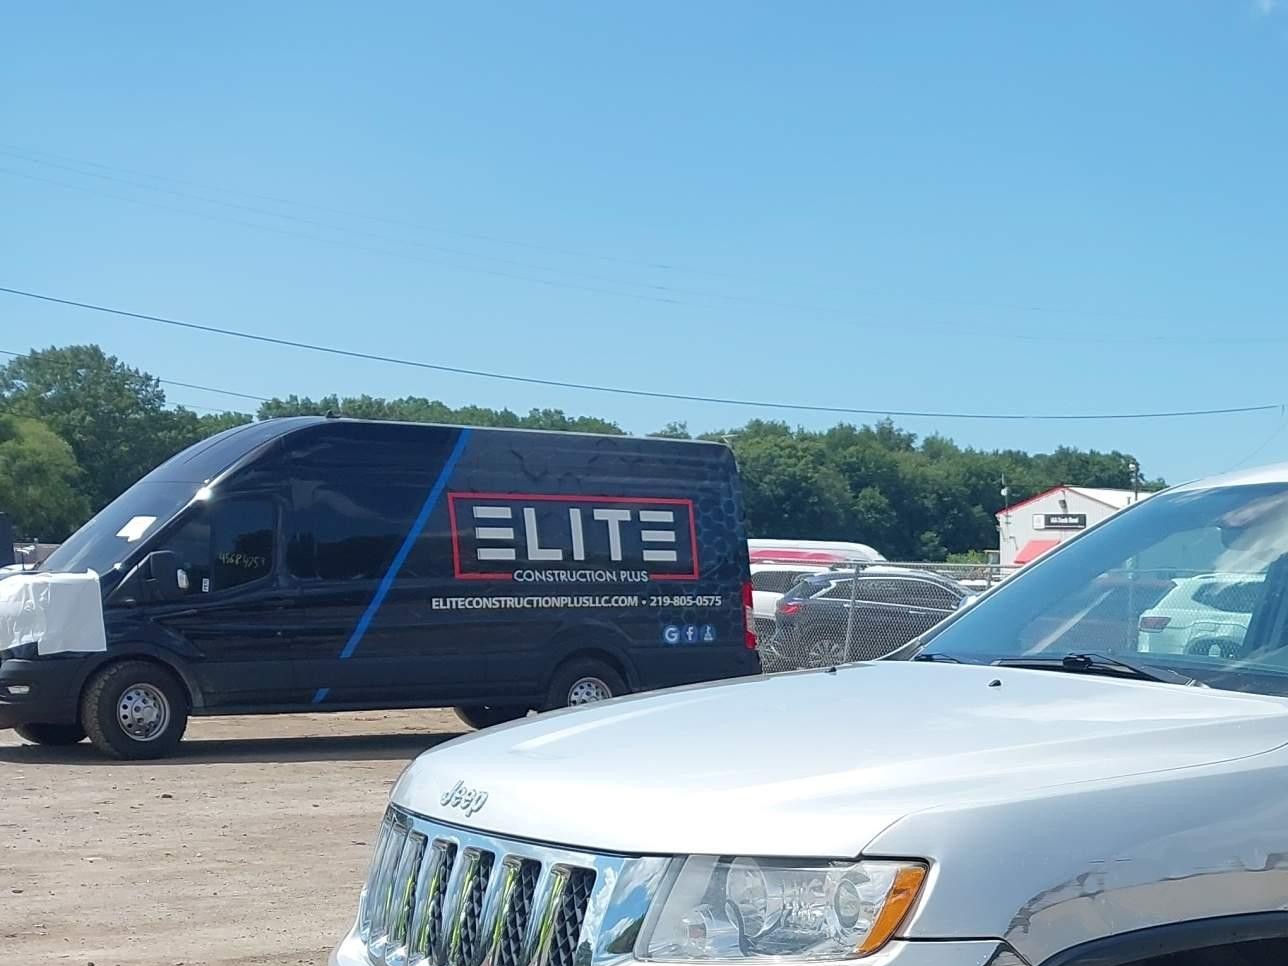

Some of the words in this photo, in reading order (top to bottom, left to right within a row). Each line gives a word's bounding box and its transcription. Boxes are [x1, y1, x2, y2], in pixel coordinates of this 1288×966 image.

[473, 505, 677, 562] ELITE
[513, 570, 616, 582] CONSTRUCTION
[620, 571, 649, 582] PLUS
[431, 596, 638, 610] ELITECONSTRUCTIONPLUSLLC.COM
[649, 596, 722, 607] 219-805-0575
[441, 780, 489, 818] Jeep
